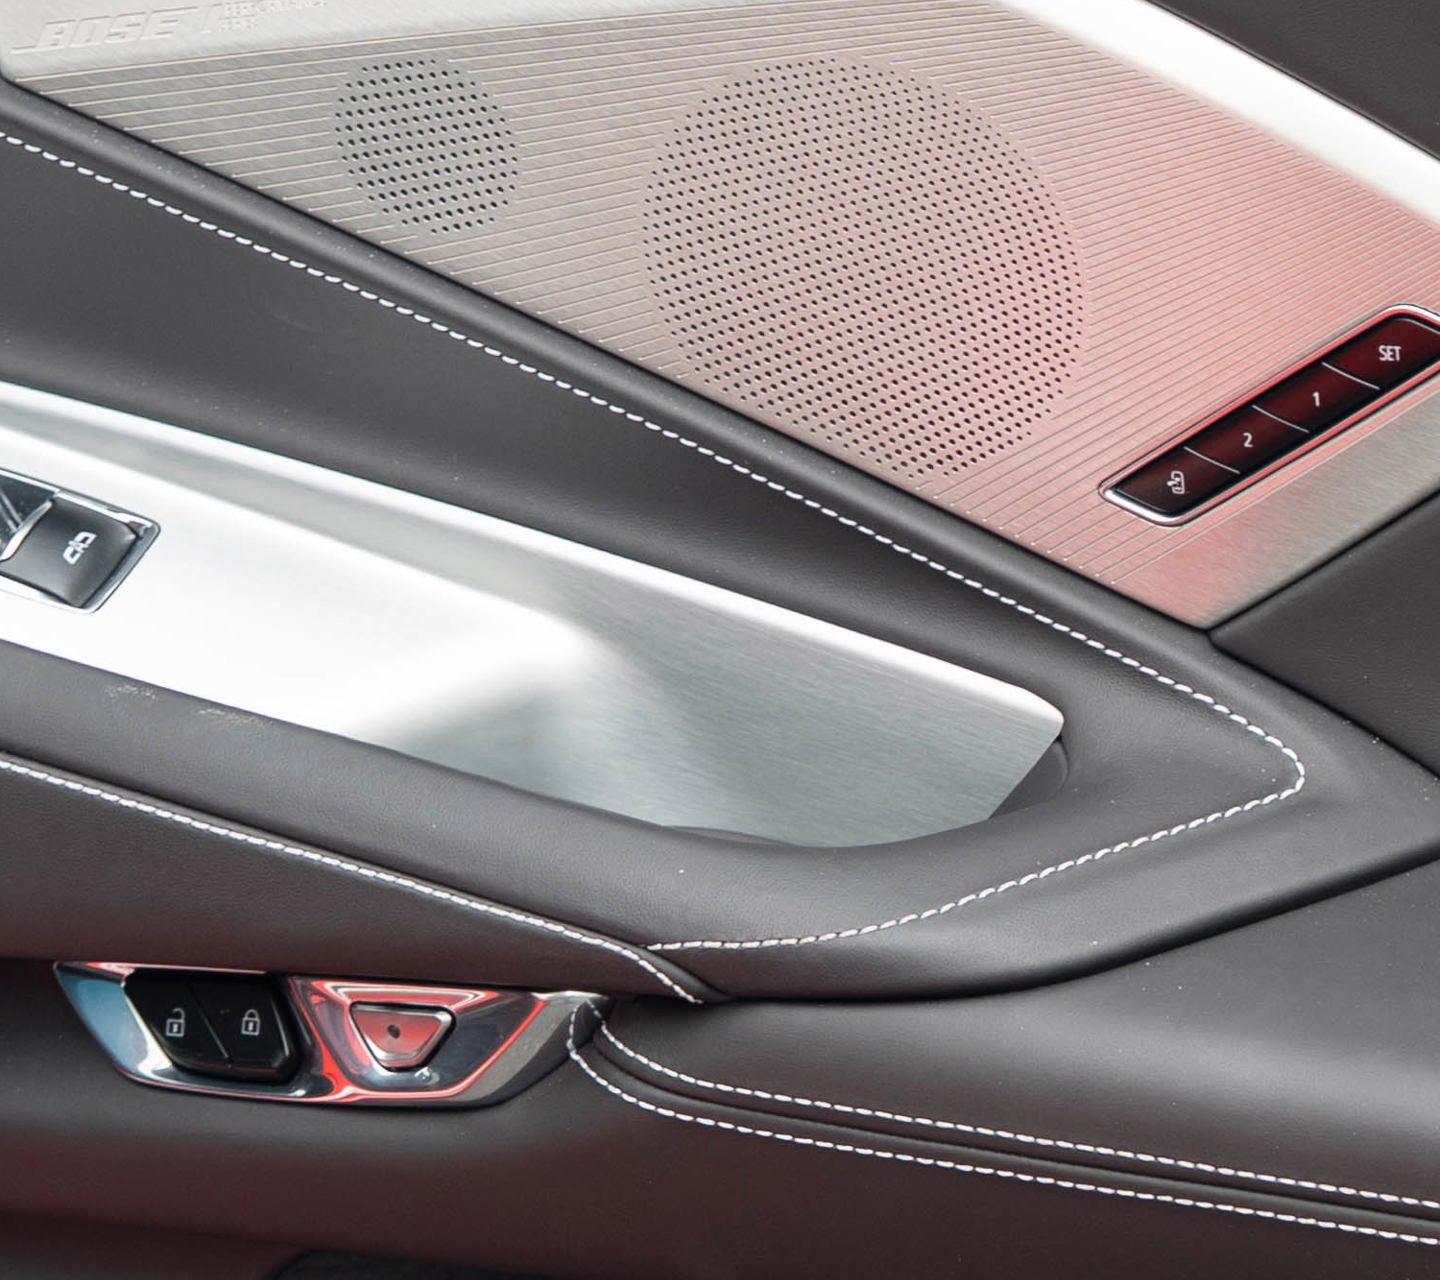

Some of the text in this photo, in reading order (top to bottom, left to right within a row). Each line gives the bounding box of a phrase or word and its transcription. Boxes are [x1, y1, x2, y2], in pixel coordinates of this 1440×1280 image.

[10, 6, 198, 55] BOSE
[1377, 344, 1402, 362] SET
[1312, 391, 1321, 408] 1
[1242, 432, 1254, 448] 2
